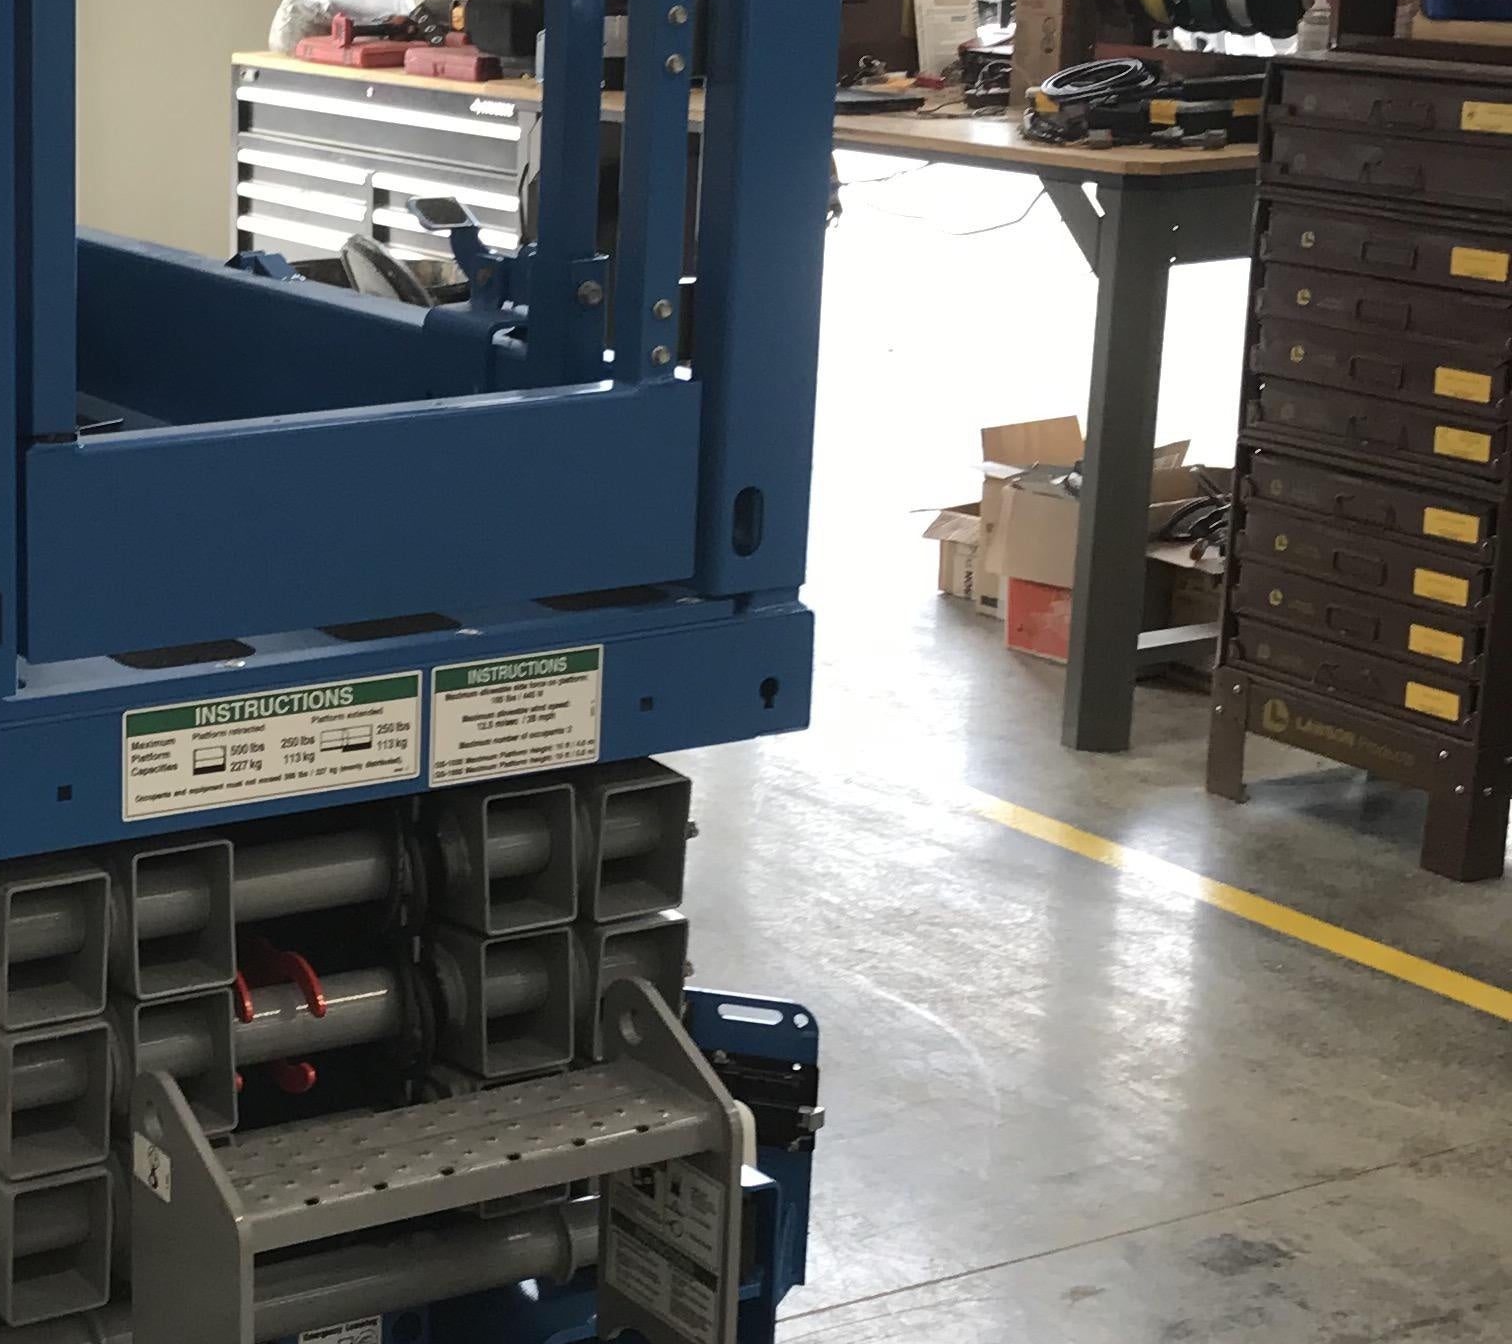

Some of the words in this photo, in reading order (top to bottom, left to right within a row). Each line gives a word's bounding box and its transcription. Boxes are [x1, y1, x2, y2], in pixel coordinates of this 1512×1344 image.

[468, 657, 568, 685] INSTRUCTIONS
[194, 686, 354, 726] INSTRUCTIONS
[376, 725, 394, 735] 250
[396, 722, 410, 732] lbs
[192, 730, 227, 741] Platform
[131, 738, 176, 751] Maximum
[251, 743, 265, 753] lbs
[281, 738, 298, 749] 250
[300, 736, 315, 745] lbs
[377, 740, 395, 751] 113
[396, 739, 407, 750] kg
[131, 751, 170, 763] Platform
[284, 754, 302, 764] 113
[303, 752, 315, 763] kg
[131, 763, 178, 777] Capacities
[230, 761, 247, 772] 227
[249, 759, 262, 771] kg
